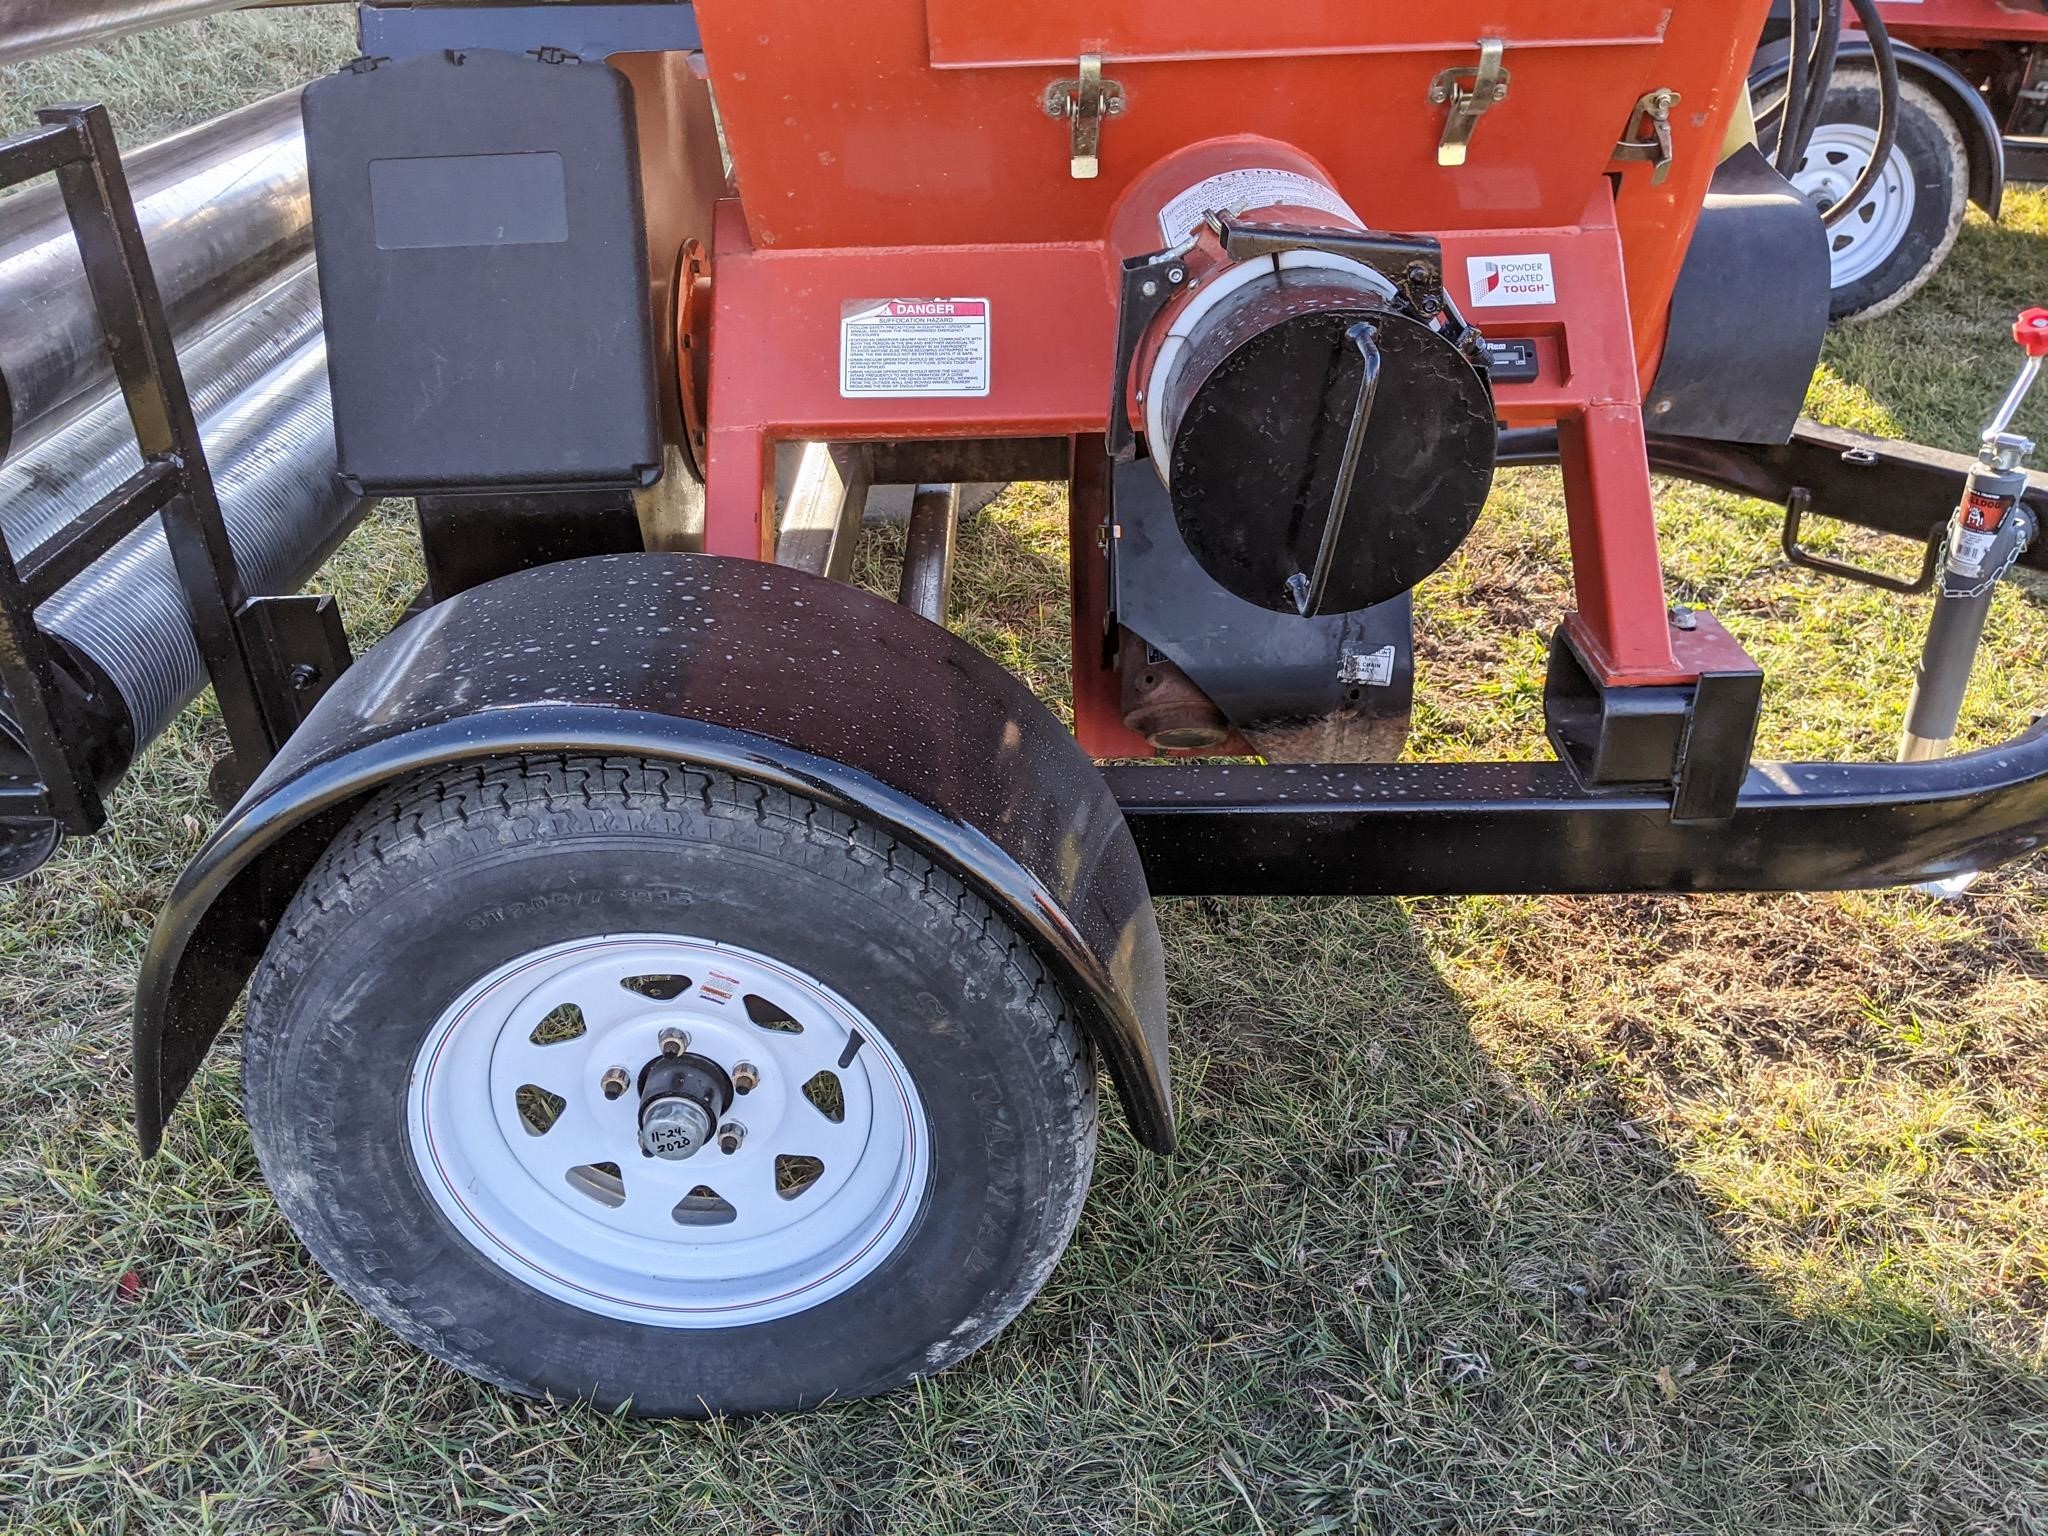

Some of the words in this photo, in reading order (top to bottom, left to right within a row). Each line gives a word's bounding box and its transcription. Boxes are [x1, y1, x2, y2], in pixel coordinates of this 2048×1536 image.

[1501, 263, 1543, 272] POWDER
[1503, 274, 1543, 283] COATED
[896, 304, 955, 315] DANGER
[651, 1127, 686, 1143] 11-24-
[657, 1136, 690, 1153] 2020
